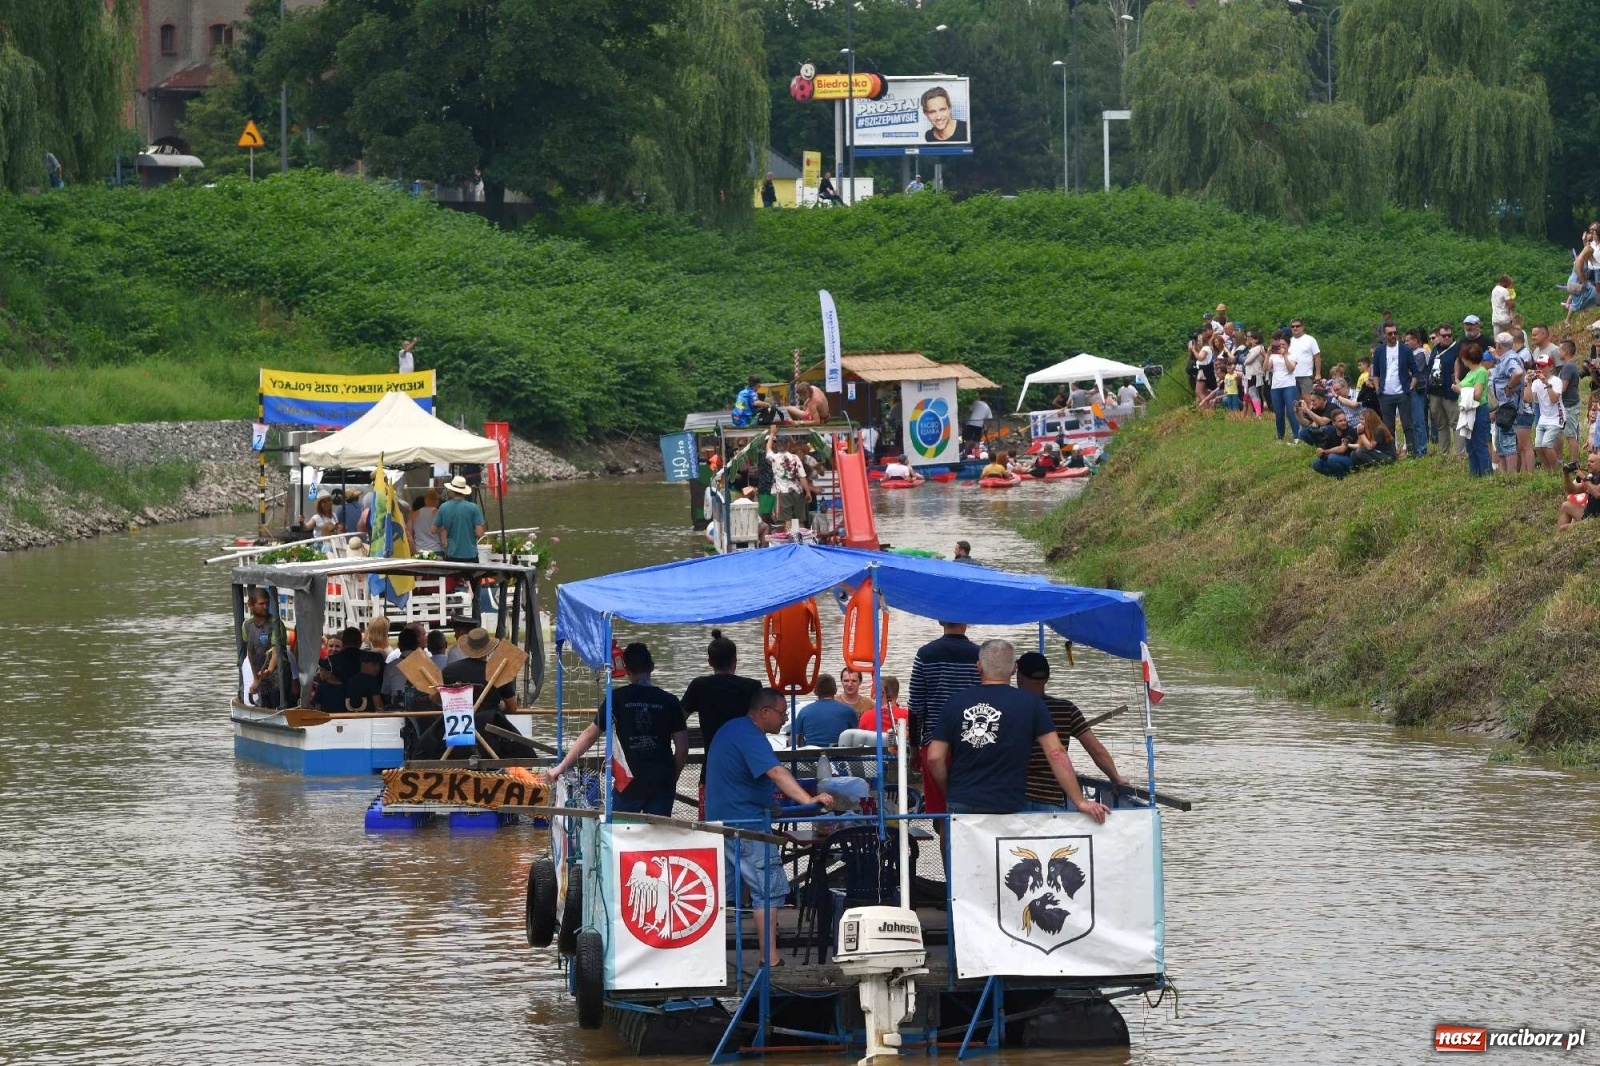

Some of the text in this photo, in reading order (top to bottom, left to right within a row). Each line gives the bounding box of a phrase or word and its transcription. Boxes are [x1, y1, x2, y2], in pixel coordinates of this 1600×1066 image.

[857, 97, 920, 115] PROSTA!
[446, 714, 473, 737] 22
[879, 922, 920, 935] Johnson
